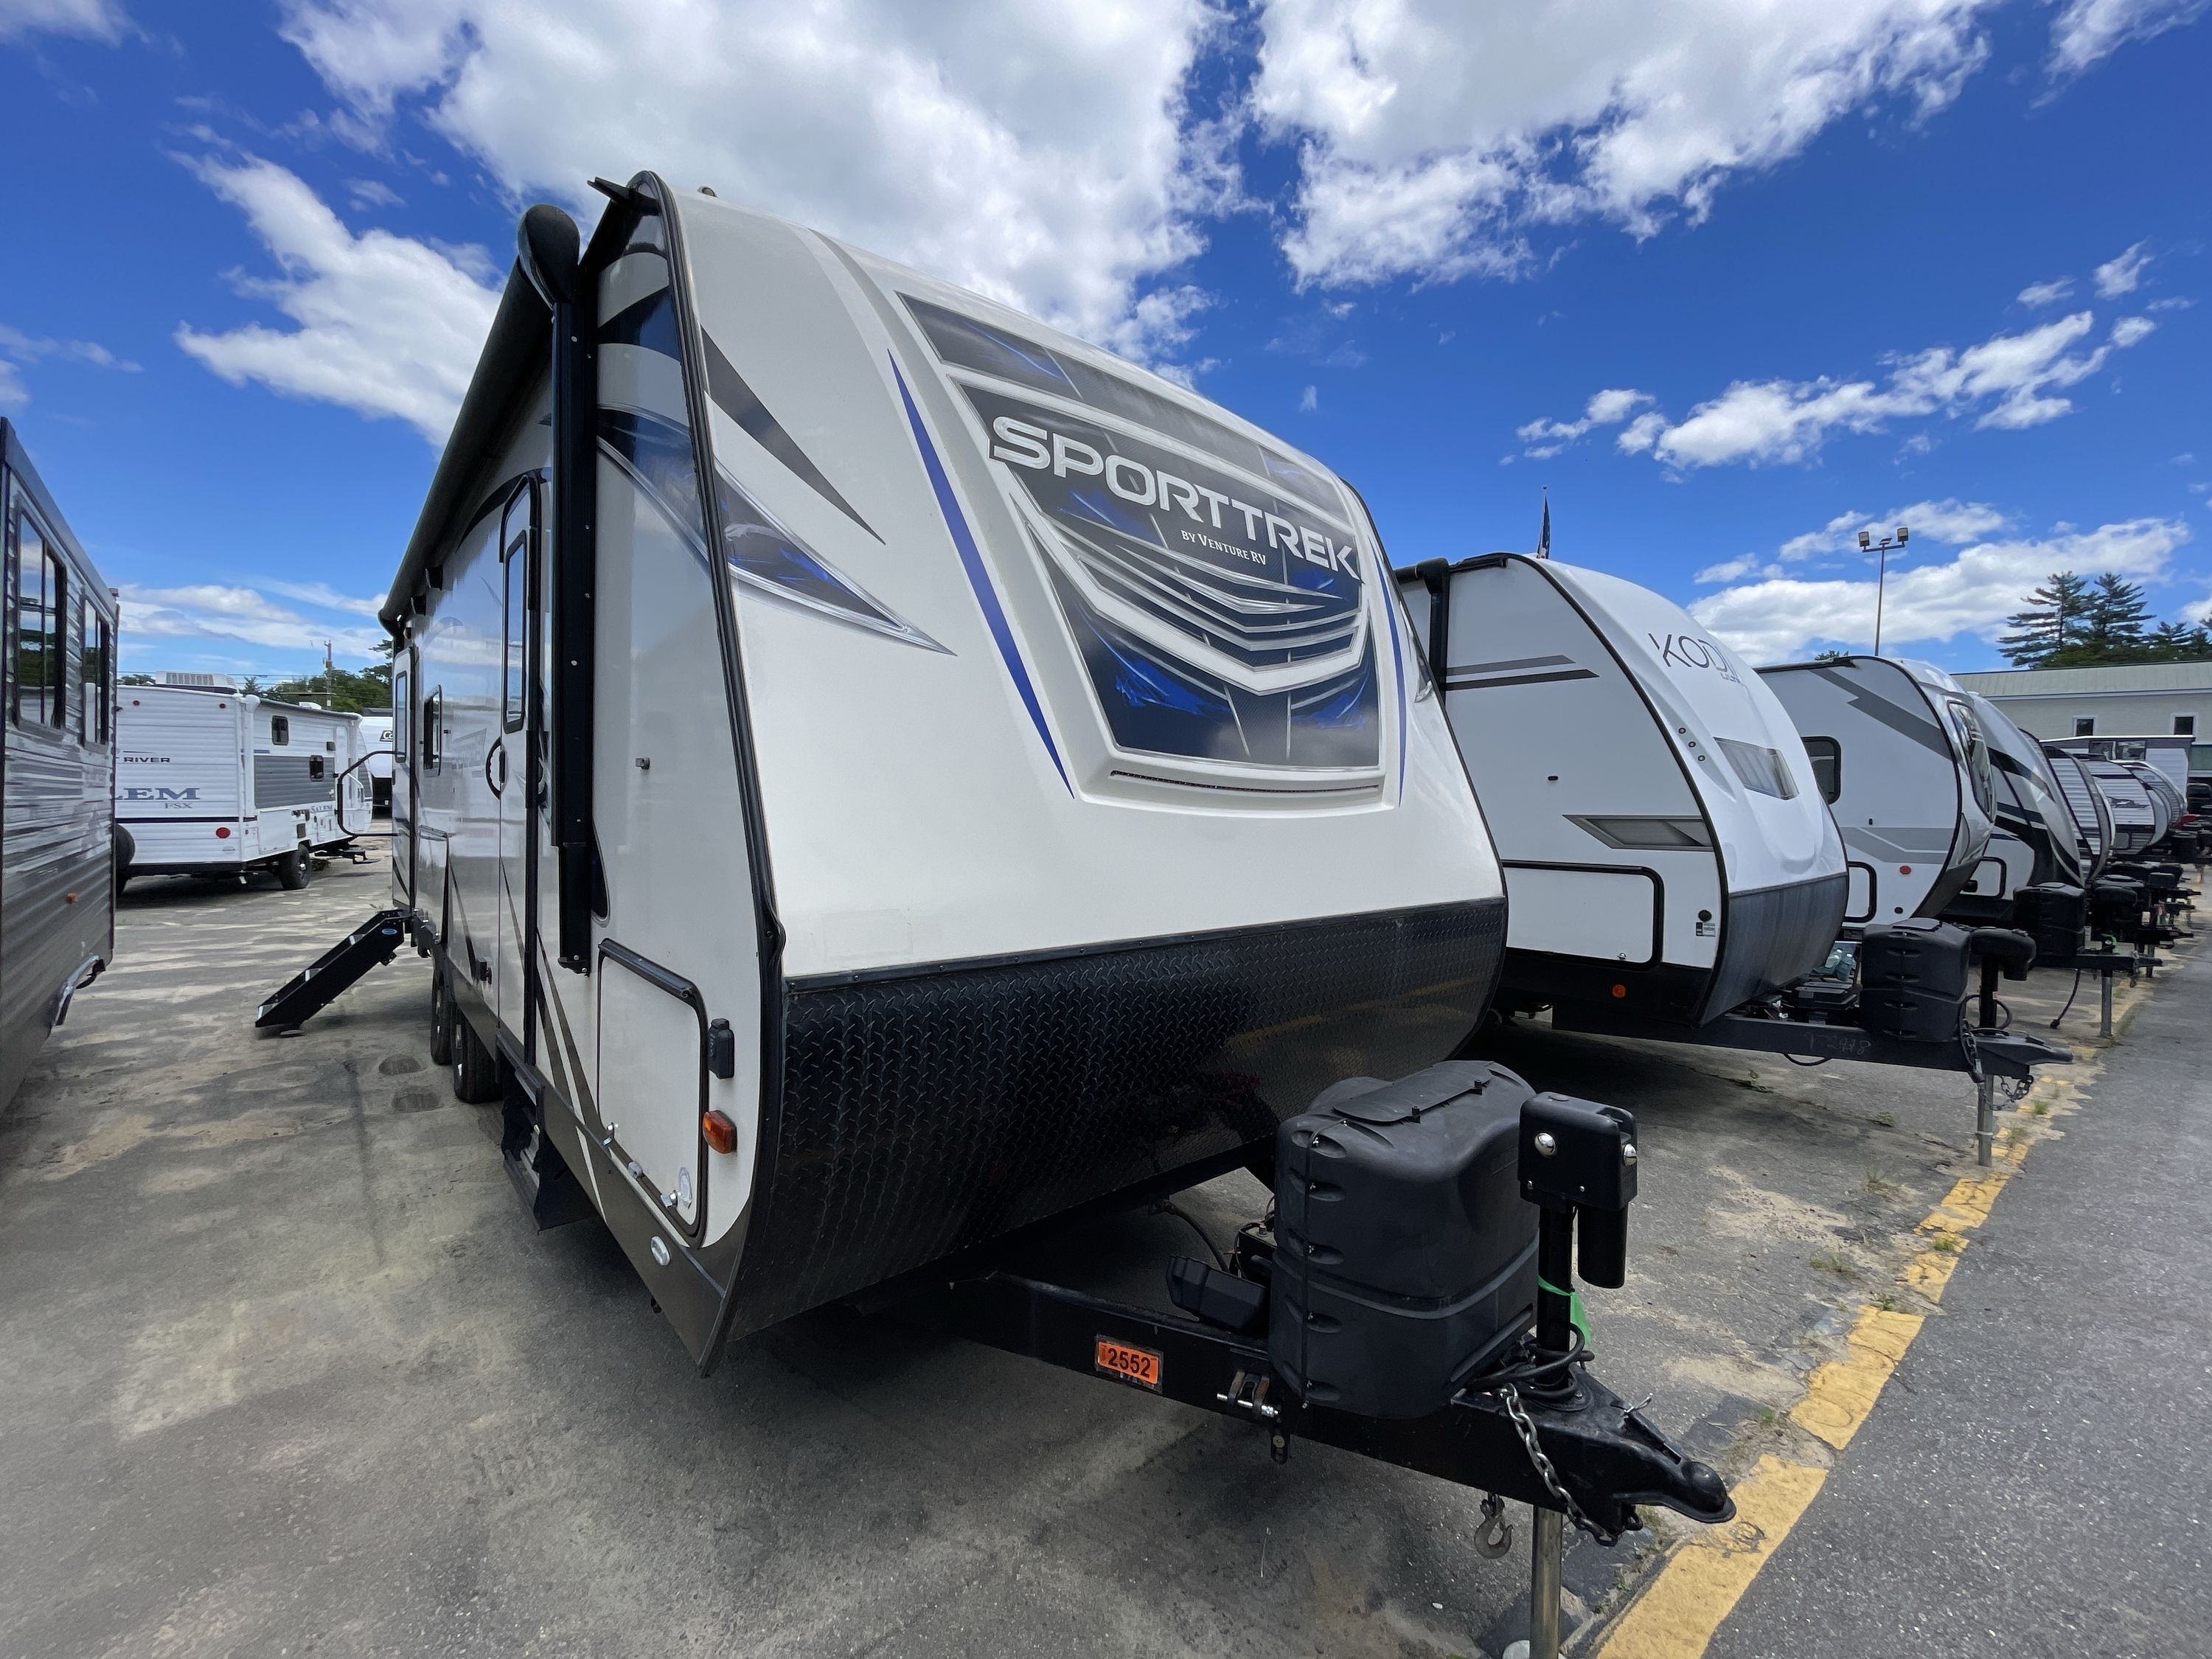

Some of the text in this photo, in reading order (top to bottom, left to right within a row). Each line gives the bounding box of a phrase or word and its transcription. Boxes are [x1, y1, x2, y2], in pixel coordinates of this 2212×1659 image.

[992, 416, 1363, 581] SPORTTREK
[1180, 529, 1196, 543] BY
[1251, 550, 1266, 566] RV
[1107, 1348, 1151, 1378] 2552
